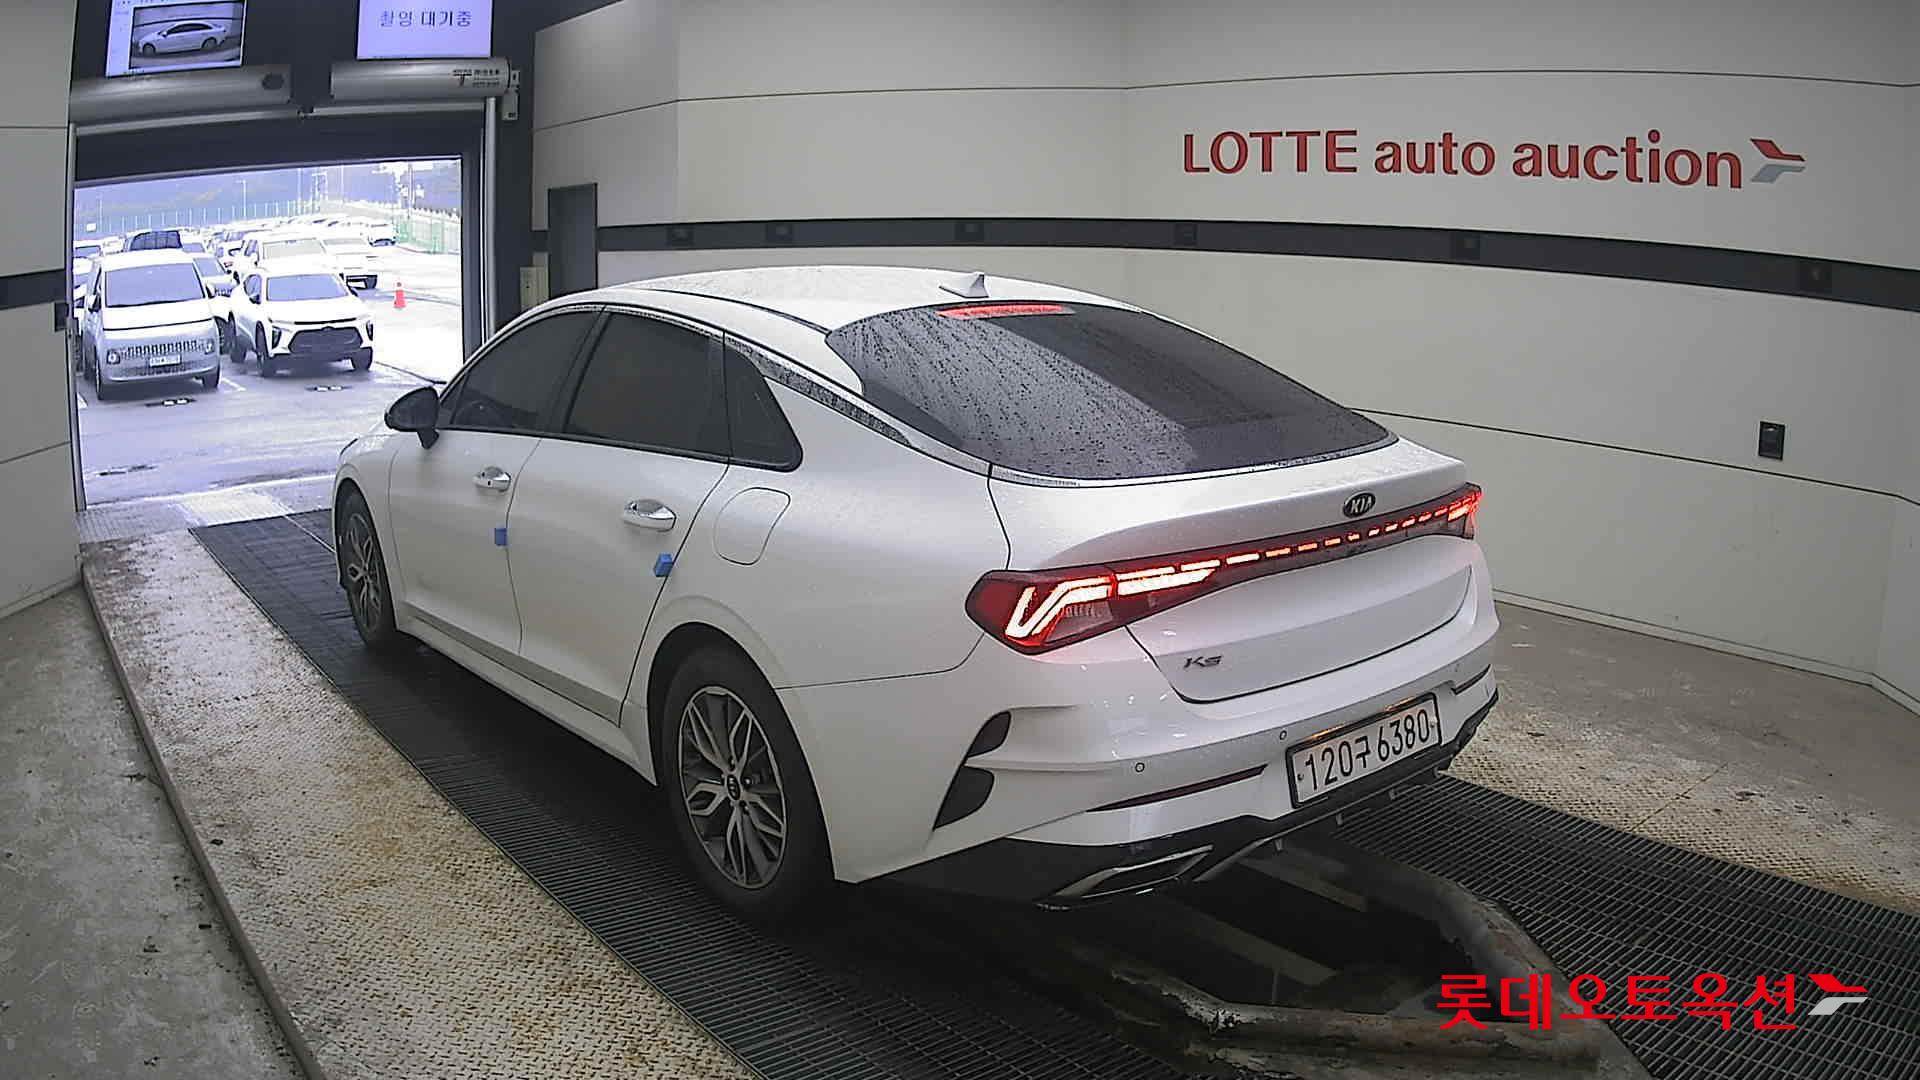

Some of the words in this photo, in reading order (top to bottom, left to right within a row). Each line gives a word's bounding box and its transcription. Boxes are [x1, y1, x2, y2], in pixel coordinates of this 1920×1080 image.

[421, 10, 472, 28] 대기중
[1184, 130, 1358, 174] LOTTE
[1374, 132, 1497, 176] auto
[1513, 129, 1743, 189] auction
[1350, 496, 1374, 513] KIA
[1304, 735, 1372, 791] 120구
[1377, 708, 1431, 762] 6380
